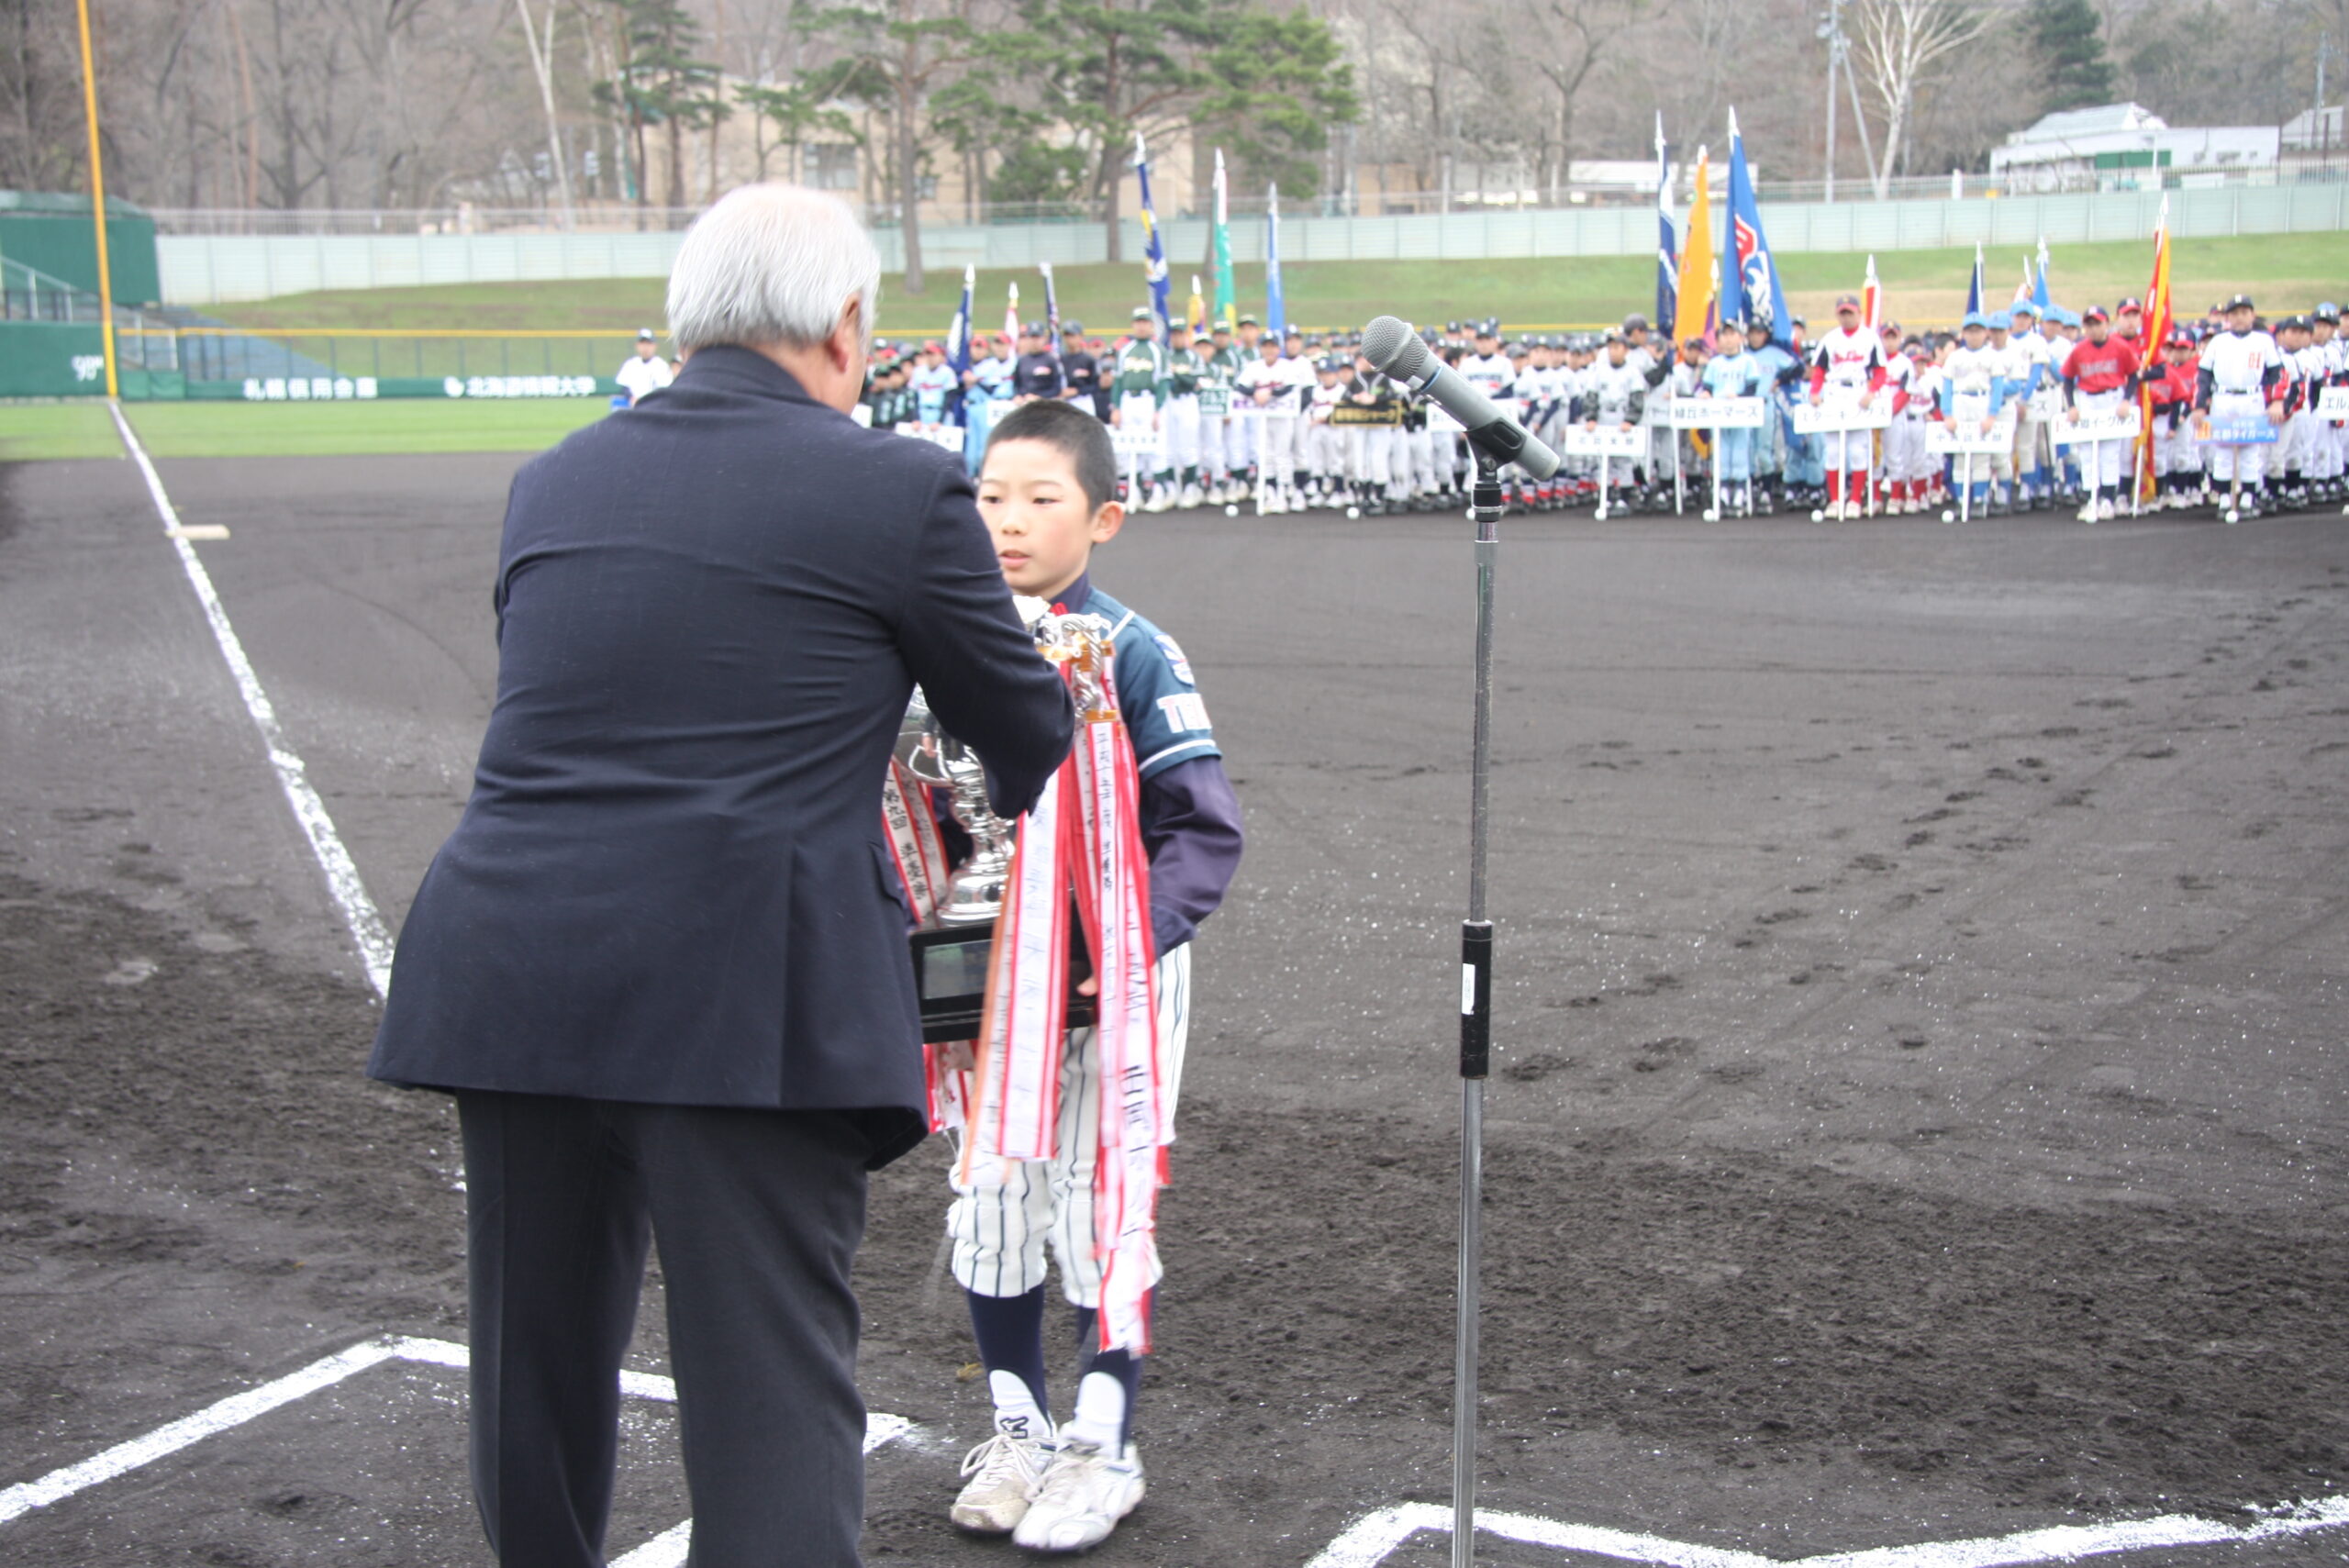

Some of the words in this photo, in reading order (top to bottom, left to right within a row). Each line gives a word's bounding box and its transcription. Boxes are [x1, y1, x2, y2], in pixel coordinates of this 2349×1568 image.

[243, 377, 378, 400] 札幌信用金庫
[466, 376, 596, 397] 北海道情報大学
